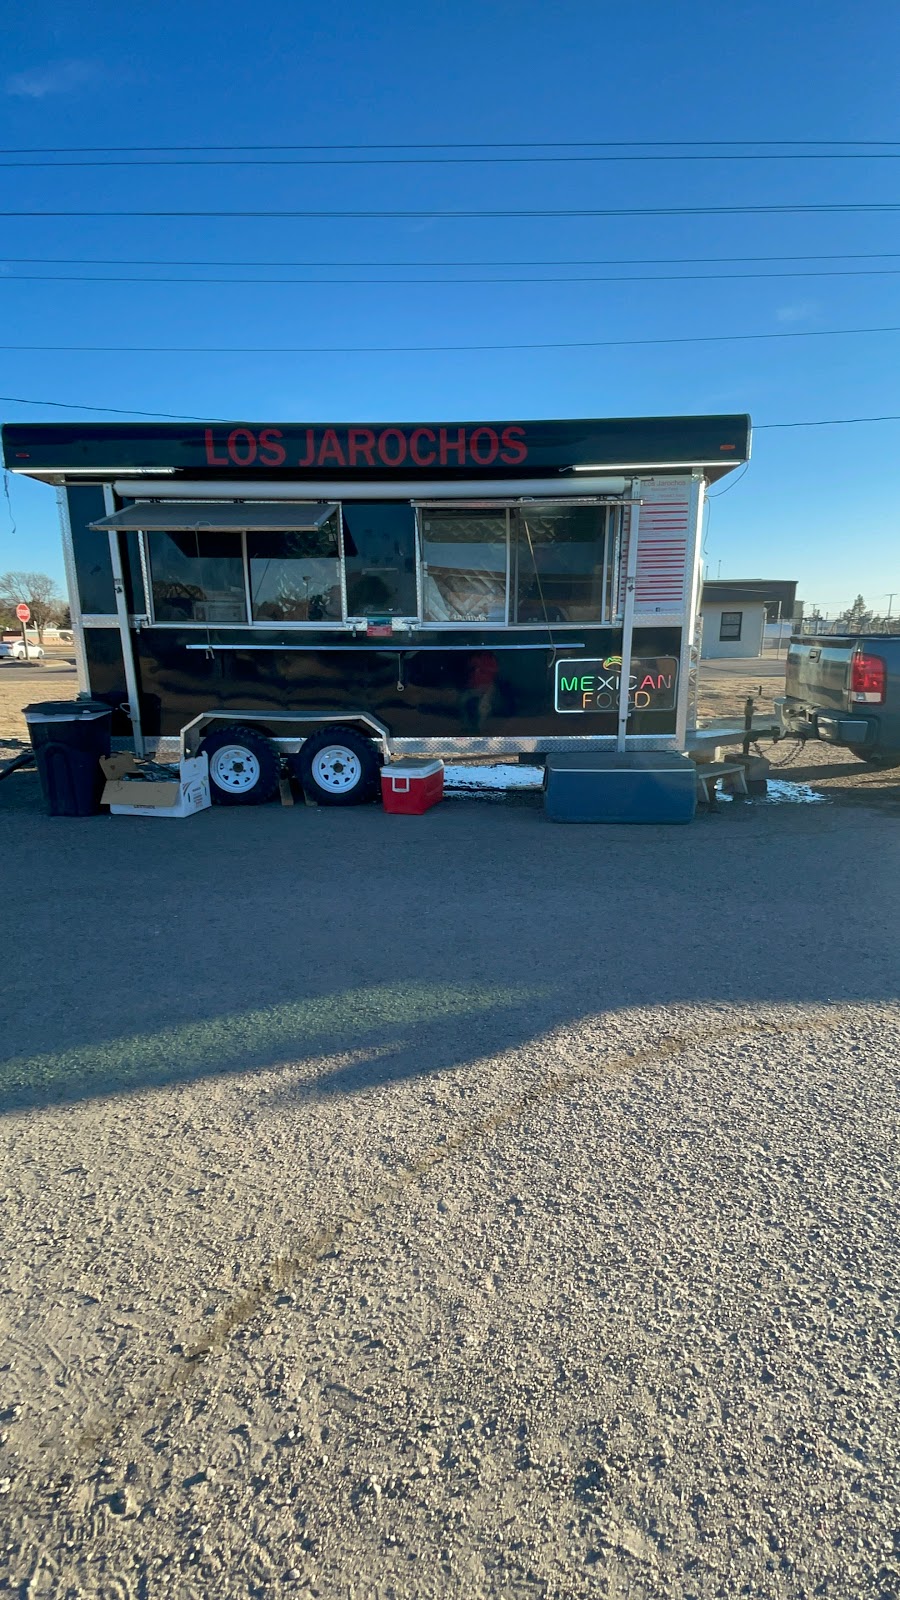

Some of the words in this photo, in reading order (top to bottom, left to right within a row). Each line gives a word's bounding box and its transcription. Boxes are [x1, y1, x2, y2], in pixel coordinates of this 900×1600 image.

[204, 428, 287, 467] LOS
[299, 426, 528, 467] JAROCHOS
[560, 674, 672, 691] MEXICAN
